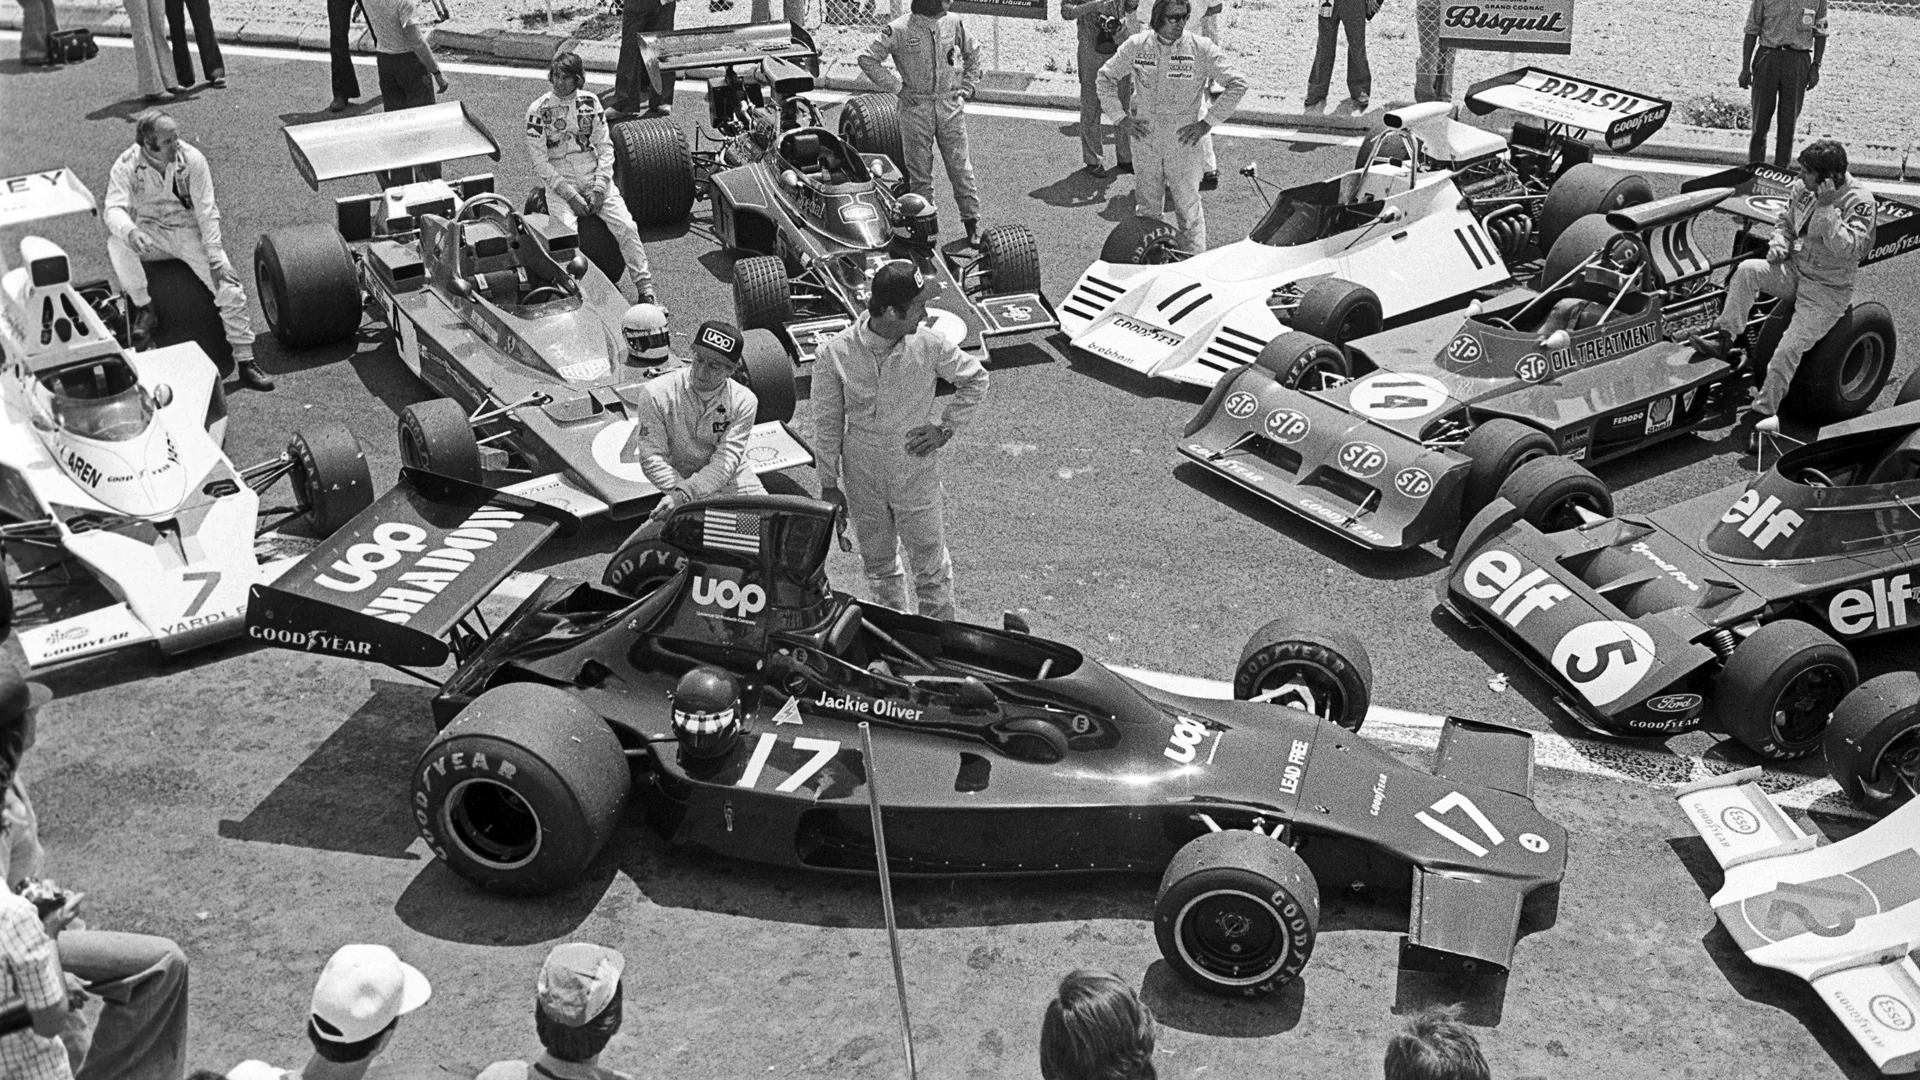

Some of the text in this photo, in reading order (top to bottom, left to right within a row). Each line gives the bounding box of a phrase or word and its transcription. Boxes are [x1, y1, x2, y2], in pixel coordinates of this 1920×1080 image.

[1444, 5, 1566, 35] Bisquit
[1535, 77, 1641, 115] BRASIL
[1613, 109, 1667, 134] GOODYEAR
[1454, 227, 1496, 271] 11
[1661, 218, 1702, 277] 14
[1867, 233, 1920, 260] GOODYEA
[1156, 282, 1213, 326] 11
[1088, 341, 1135, 365] brabham
[1450, 336, 1478, 358] STP
[1520, 322, 1657, 380] STP OIL TREATMENT
[1227, 394, 1256, 416] STP
[1269, 412, 1305, 435] STP
[1613, 412, 1644, 426] FERODO
[1343, 445, 1381, 469] STP
[1397, 471, 1431, 496] STP
[1721, 489, 1805, 551] elf
[182, 571, 222, 618] 7
[1463, 550, 1573, 628] elf
[1828, 573, 1913, 635] elf
[160, 604, 248, 637] YARDLE
[248, 624, 373, 657] GOODYEAR
[1566, 638, 1638, 684] 5
[814, 691, 925, 721] Jackie Oliver
[1657, 695, 1693, 710] Ford
[1629, 717, 1701, 730] GOODYEAR
[738, 732, 841, 793] 17
[1279, 739, 1309, 795] LEAD FREE
[1370, 772, 1388, 817] GOODYEAR
[1413, 790, 1506, 858] 17
[1693, 803, 1731, 848] GOODYEAR
[1834, 991, 1885, 1048] GOODYEAR
